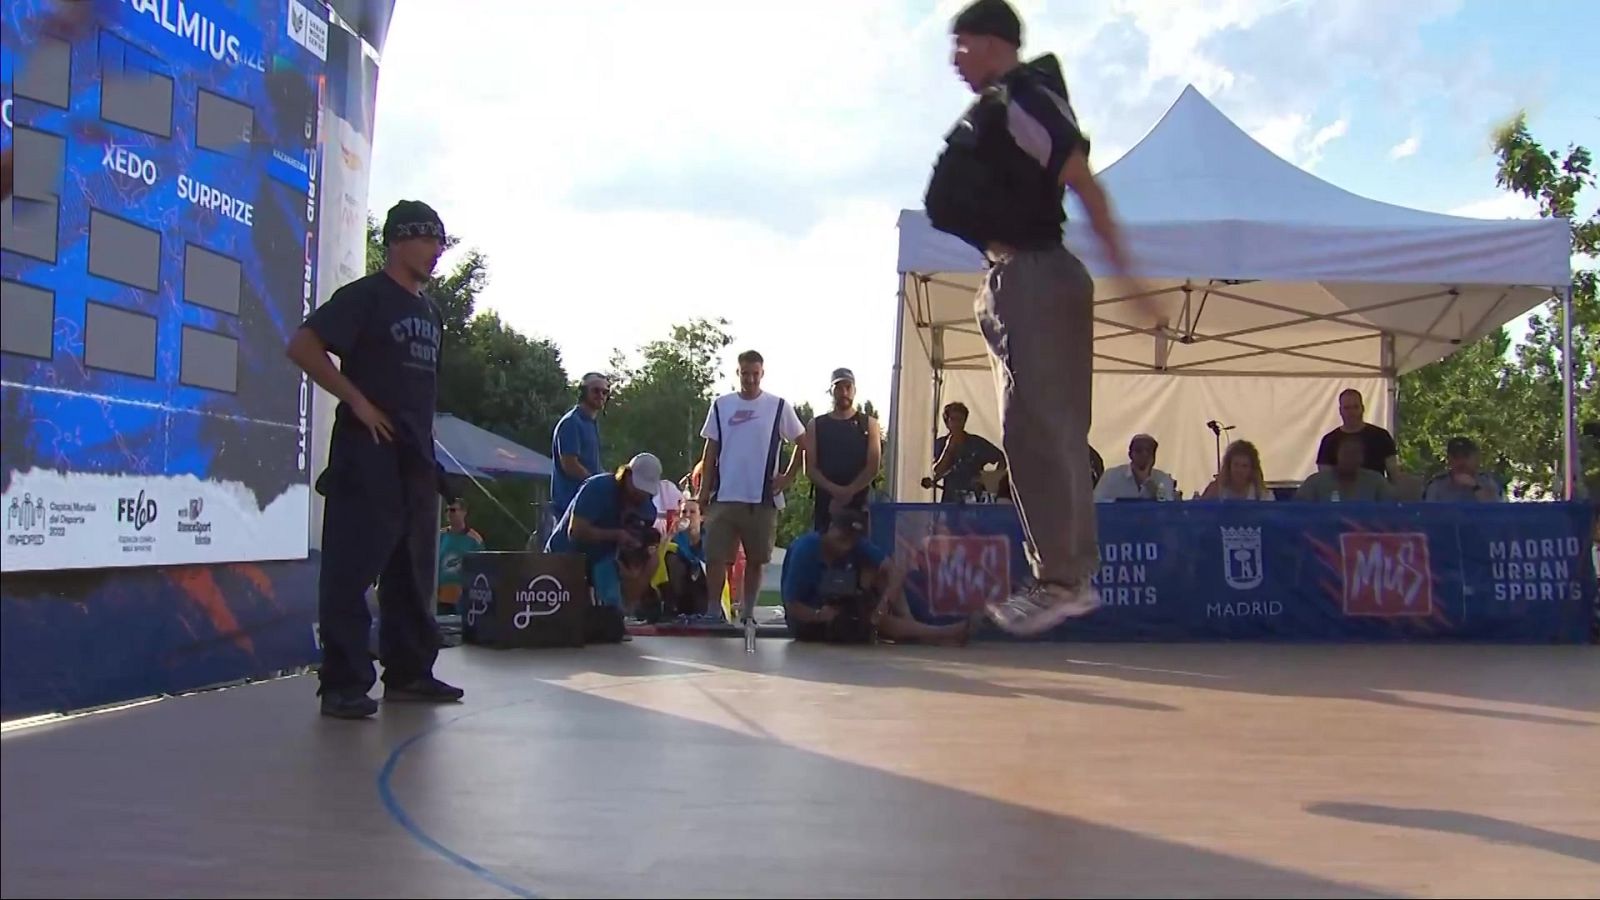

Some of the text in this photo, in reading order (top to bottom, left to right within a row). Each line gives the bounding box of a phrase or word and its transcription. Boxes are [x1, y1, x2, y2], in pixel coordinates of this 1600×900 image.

[102, 146, 157, 186] XEDO
[176, 175, 254, 227] SURPRIZE
[1488, 537, 1580, 558] MADRID
[1491, 559, 1569, 580] URBAN
[516, 590, 570, 607] imagin
[1494, 582, 1583, 601] SPORTS
[1206, 600, 1283, 618] MADRID
